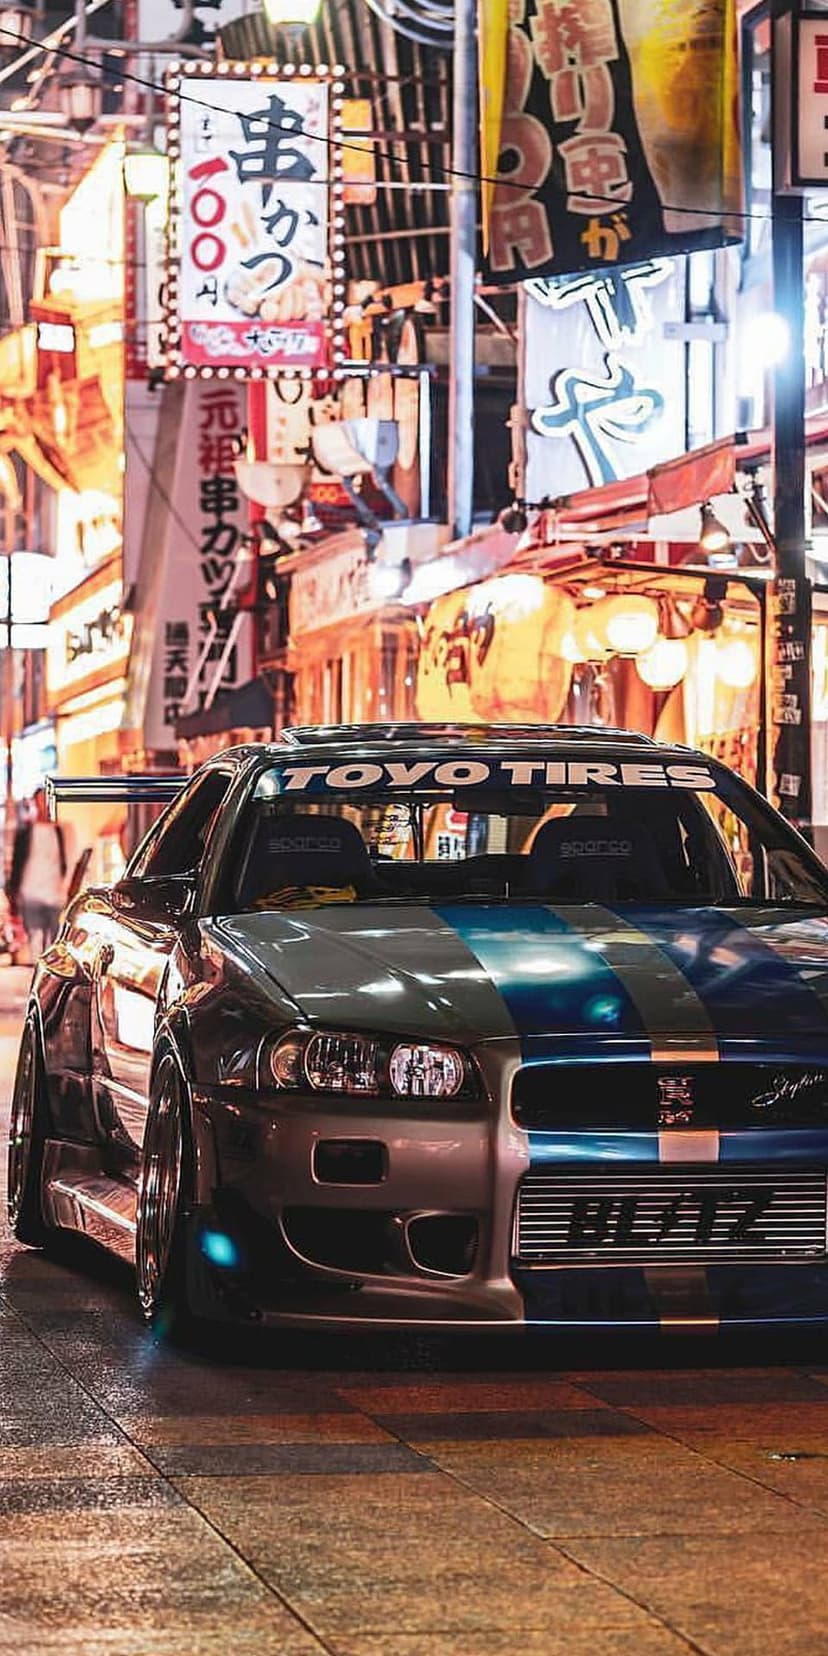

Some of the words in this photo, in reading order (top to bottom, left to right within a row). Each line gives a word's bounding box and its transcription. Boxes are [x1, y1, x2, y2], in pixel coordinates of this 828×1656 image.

[229, 94, 318, 292] 串かつ
[284, 761, 489, 790] TOYO
[500, 761, 717, 789] TIRES
